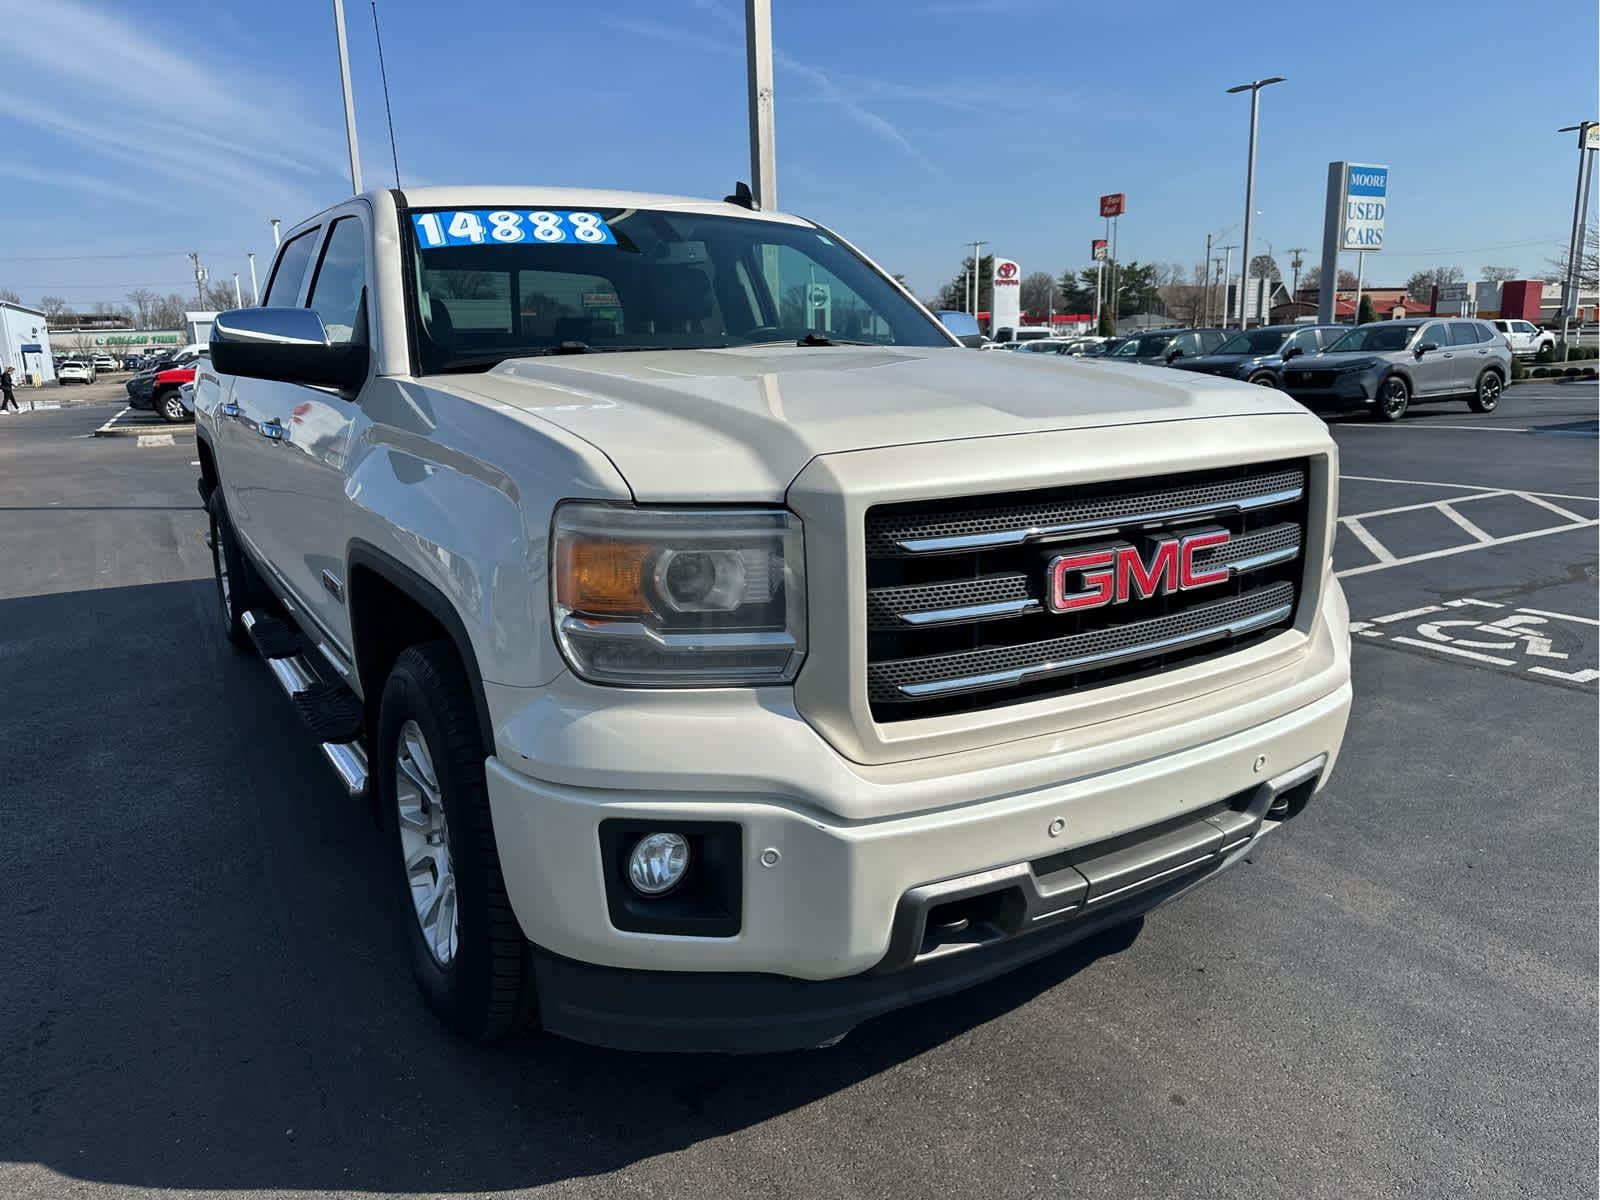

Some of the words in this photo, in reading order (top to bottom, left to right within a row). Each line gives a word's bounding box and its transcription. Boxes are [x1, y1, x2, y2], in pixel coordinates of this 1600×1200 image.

[1351, 174, 1385, 187] MOORE
[1348, 202, 1384, 220] USED
[417, 211, 607, 246] 14888
[1346, 227, 1383, 245] CARS
[1048, 529, 1231, 614] GMC
